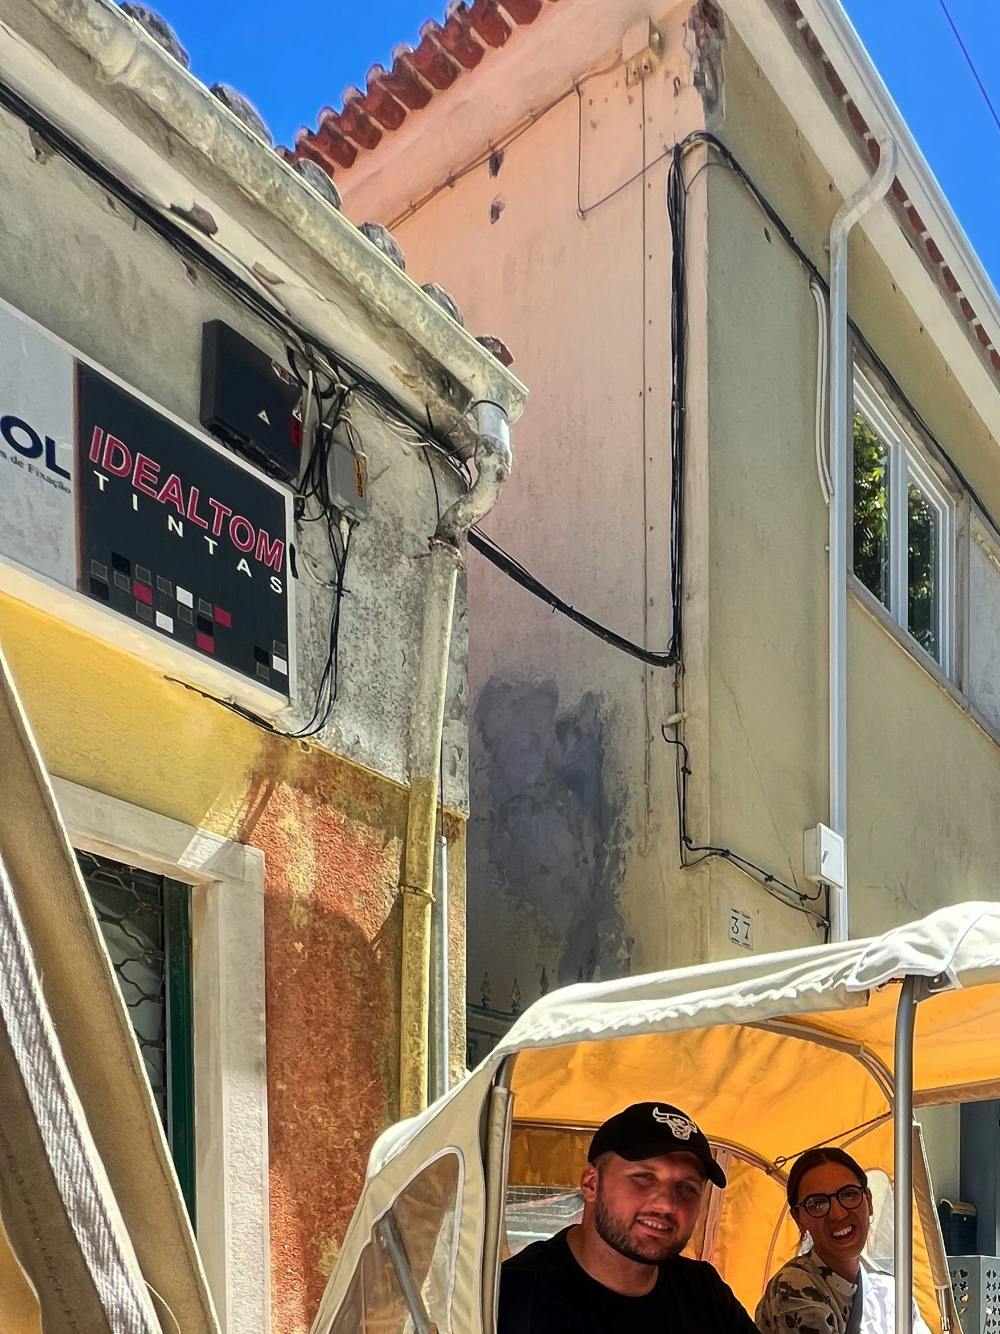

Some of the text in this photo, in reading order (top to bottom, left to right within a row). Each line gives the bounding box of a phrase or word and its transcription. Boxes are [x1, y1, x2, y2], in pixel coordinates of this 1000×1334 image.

[0, 415, 72, 481] OL
[10, 455, 25, 469] de
[27, 463, 72, 495] Fixação
[88, 425, 285, 573] IDEALTOM
[731, 915, 751, 940] 37
